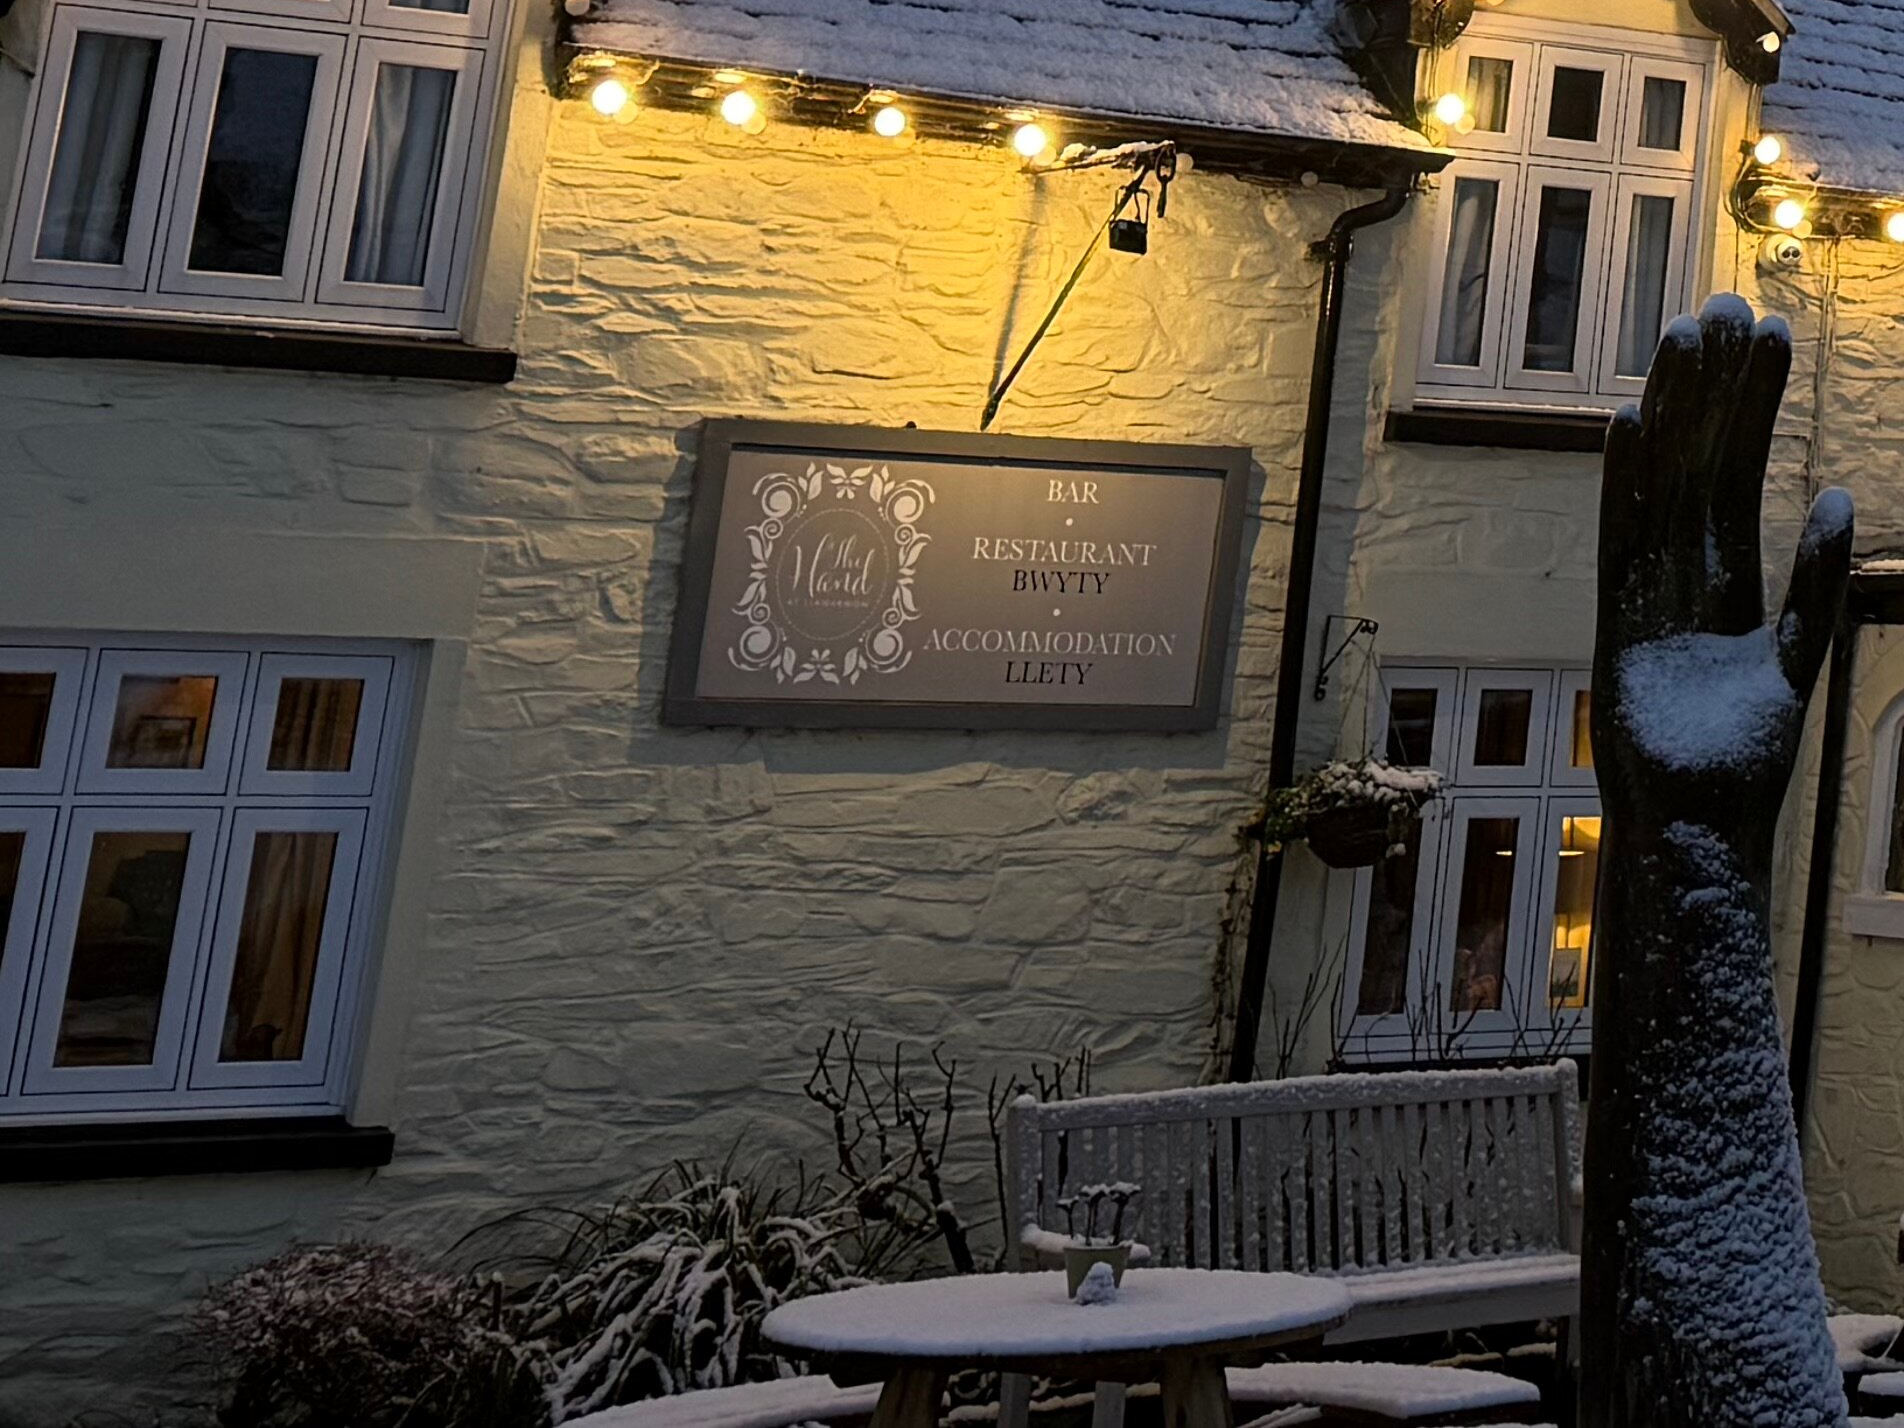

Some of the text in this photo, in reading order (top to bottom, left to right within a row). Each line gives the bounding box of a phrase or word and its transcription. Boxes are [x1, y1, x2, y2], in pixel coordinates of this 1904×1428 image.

[1047, 479, 1100, 505] BAR
[971, 536, 1158, 566] RESTAURANT
[1012, 569, 1112, 595] BWYTY
[922, 627, 1178, 657] ACCOMMODATION
[1005, 660, 1094, 686] LLETY
